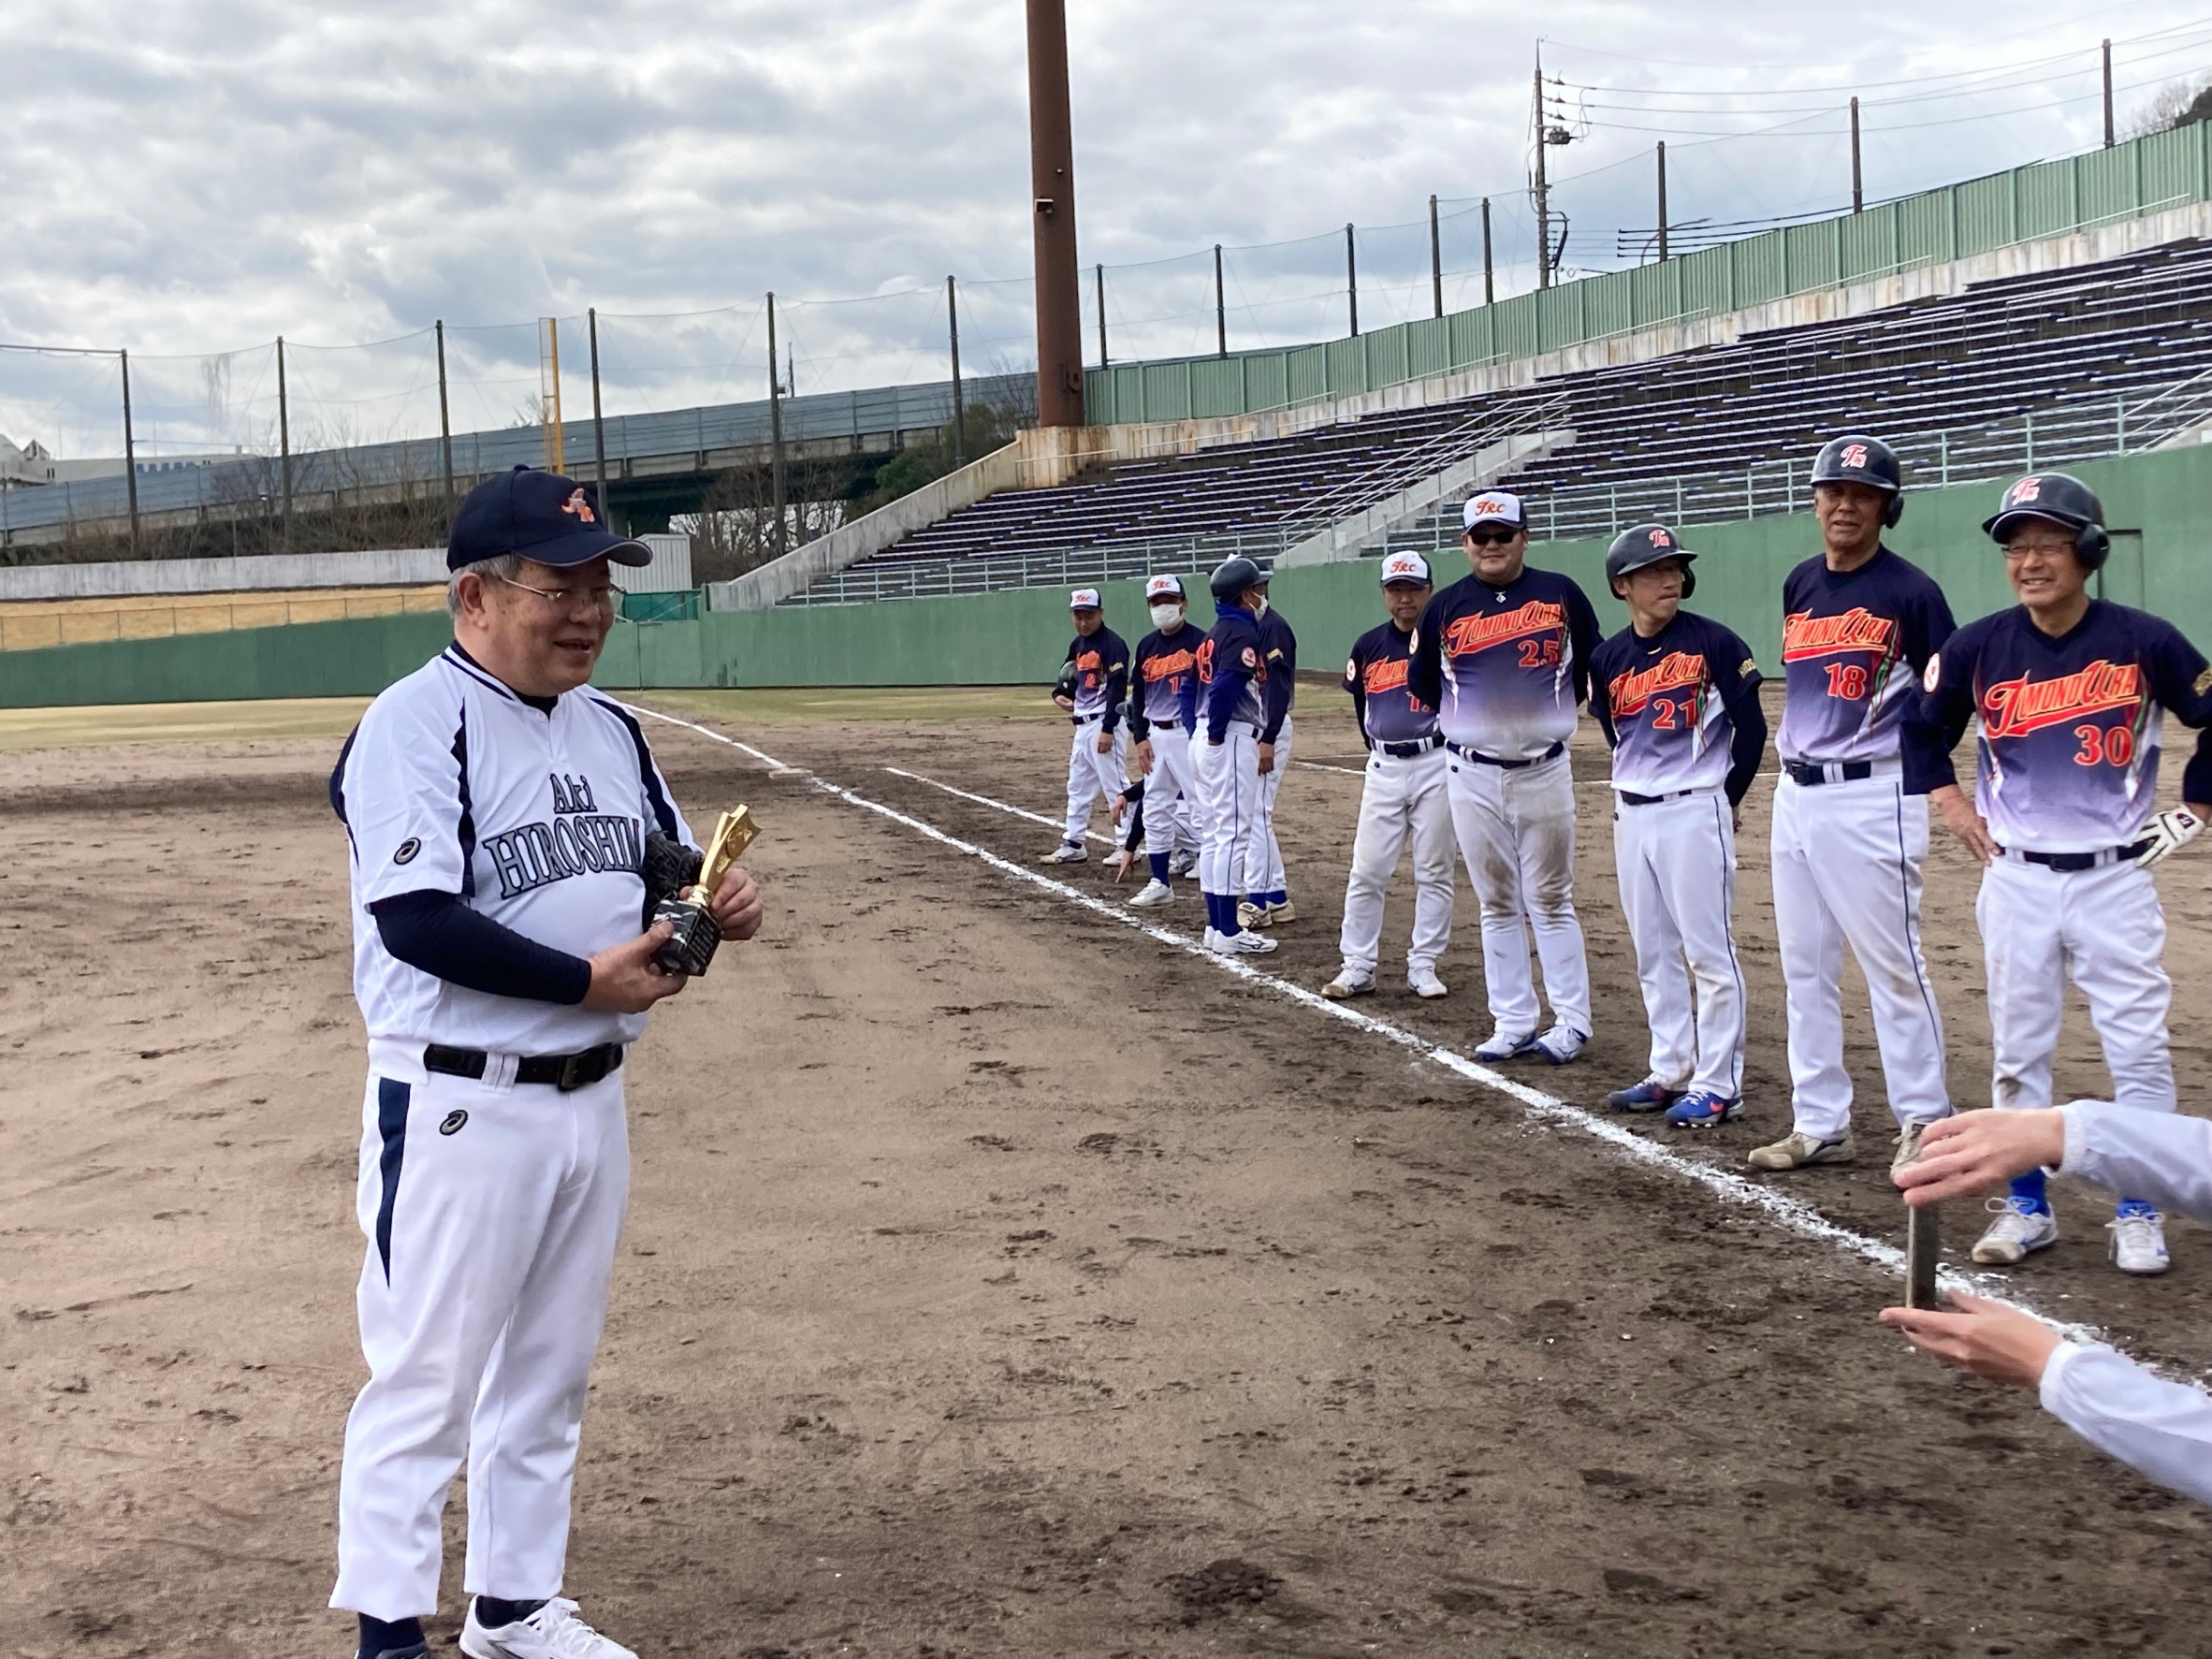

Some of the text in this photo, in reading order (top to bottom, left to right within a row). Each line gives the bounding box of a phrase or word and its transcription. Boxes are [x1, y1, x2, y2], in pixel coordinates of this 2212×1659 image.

[1517, 640, 1560, 667] 25
[1169, 676, 1186, 694] 1
[1824, 662, 1868, 701] 18
[1652, 698, 1696, 730] 21
[2074, 724, 2133, 767] 30
[549, 773, 598, 814] Aki
